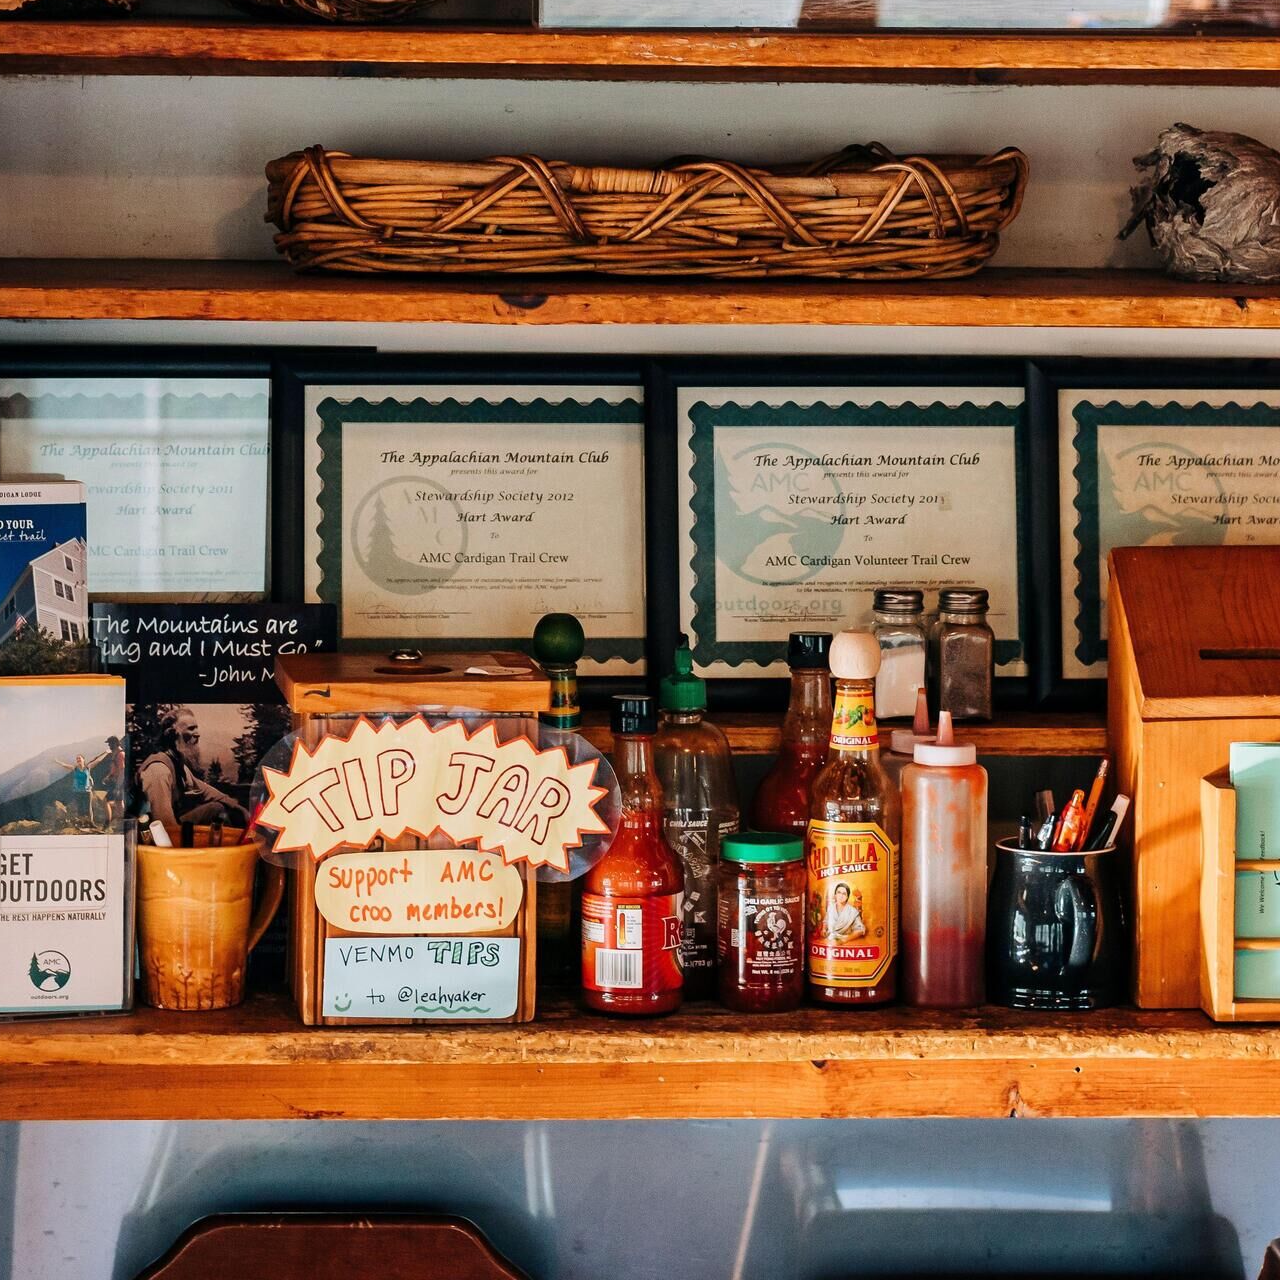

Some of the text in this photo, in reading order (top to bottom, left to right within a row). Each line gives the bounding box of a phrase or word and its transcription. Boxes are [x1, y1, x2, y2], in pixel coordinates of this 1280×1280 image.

[40, 440, 272, 460] The Appalachian Mountain Club
[380, 450, 609, 468] The Appalachian Mountain Club
[753, 452, 980, 471] The Appalachian Mountain Club
[1136, 453, 1161, 467] The
[1165, 453, 1254, 470] Appalachian
[751, 472, 810, 493] AMC
[822, 470, 854, 481] presents
[872, 470, 897, 478] award
[898, 470, 911, 481] for
[1133, 471, 1193, 492] AMC
[88, 482, 234, 500] ewardship Society 2011
[414, 489, 574, 505] Stewardship Society 2012
[788, 491, 867, 508] Stewardship
[870, 493, 915, 508] Society
[1170, 491, 1249, 508] Stewardship
[115, 503, 194, 517] Hart Award
[455, 511, 536, 523] Hart Award
[6, 519, 35, 531] YOUR
[829, 513, 909, 526] Hart Award
[1211, 513, 1242, 525] Hart
[19, 528, 47, 542] trail
[489, 531, 500, 540] To
[863, 534, 873, 542] To
[1244, 533, 1256, 543] To
[89, 544, 230, 560] MC Cardigan Trail Crew
[418, 551, 569, 567] AMC Cardigan Trail Crew
[765, 553, 971, 569] AMC Cardigan Volunteer Trail Crew
[136, 613, 259, 634] Mountains
[265, 618, 299, 635] are
[148, 637, 192, 657] and
[200, 640, 206, 657] I
[212, 640, 272, 657] Must
[832, 735, 872, 745] ORIGINAL
[279, 748, 571, 846] TIP JAR
[810, 842, 878, 875] CHOLULA
[328, 858, 494, 898] Support AMC
[820, 863, 872, 878] HOT SAUCE
[12, 913, 30, 922] REST
[31, 911, 66, 921] HAPPENS
[67, 911, 107, 921] NATURALLY
[349, 895, 504, 926] croo members!
[339, 940, 500, 968] VENMO TIPS
[812, 945, 874, 959] ORIGINAL
[42, 958, 62, 966] AMC
[365, 985, 487, 1009] to @leahyaker
